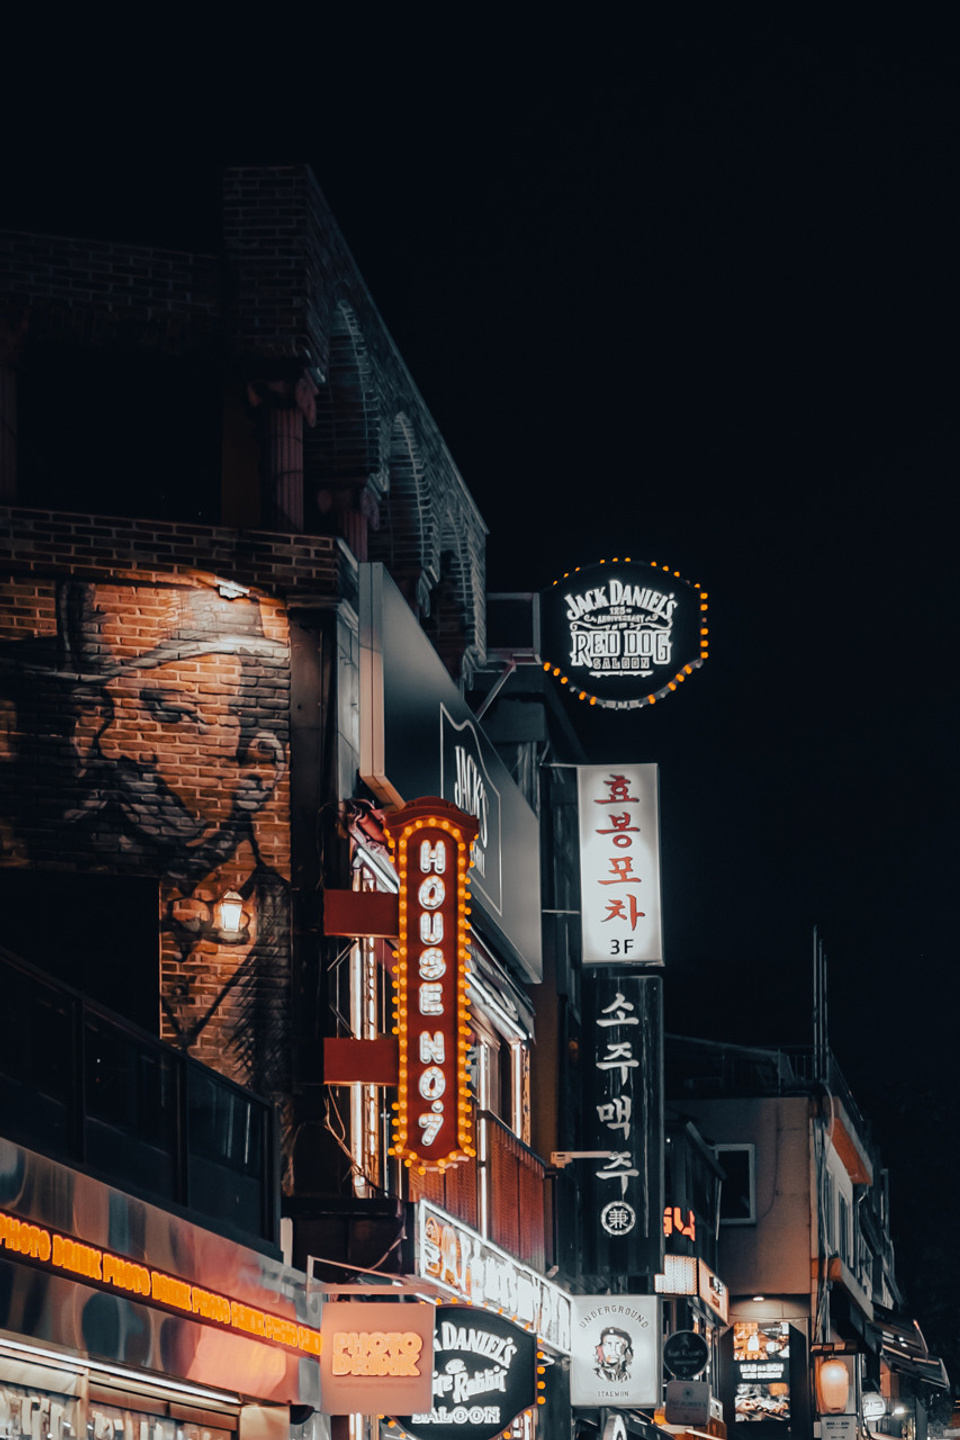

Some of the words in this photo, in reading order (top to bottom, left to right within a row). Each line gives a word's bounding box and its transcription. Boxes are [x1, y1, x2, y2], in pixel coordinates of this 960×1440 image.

[564, 587, 610, 620] JACK
[609, 579, 678, 620] DANIEL'S
[570, 630, 620, 667] RED
[624, 630, 672, 665] DOG
[592, 657, 650, 670] SALOON
[593, 774, 646, 931] 효봉포차
[418, 839, 447, 1016] HOUSE
[610, 939, 634, 955] 3F
[596, 993, 640, 1195] 소주맥주
[578, 1304, 650, 1329] UNDERGROUND
[333, 1332, 423, 1356] PHOTO
[441, 1321, 518, 1369] DANIEL'S
[332, 1353, 421, 1376] DRINK
